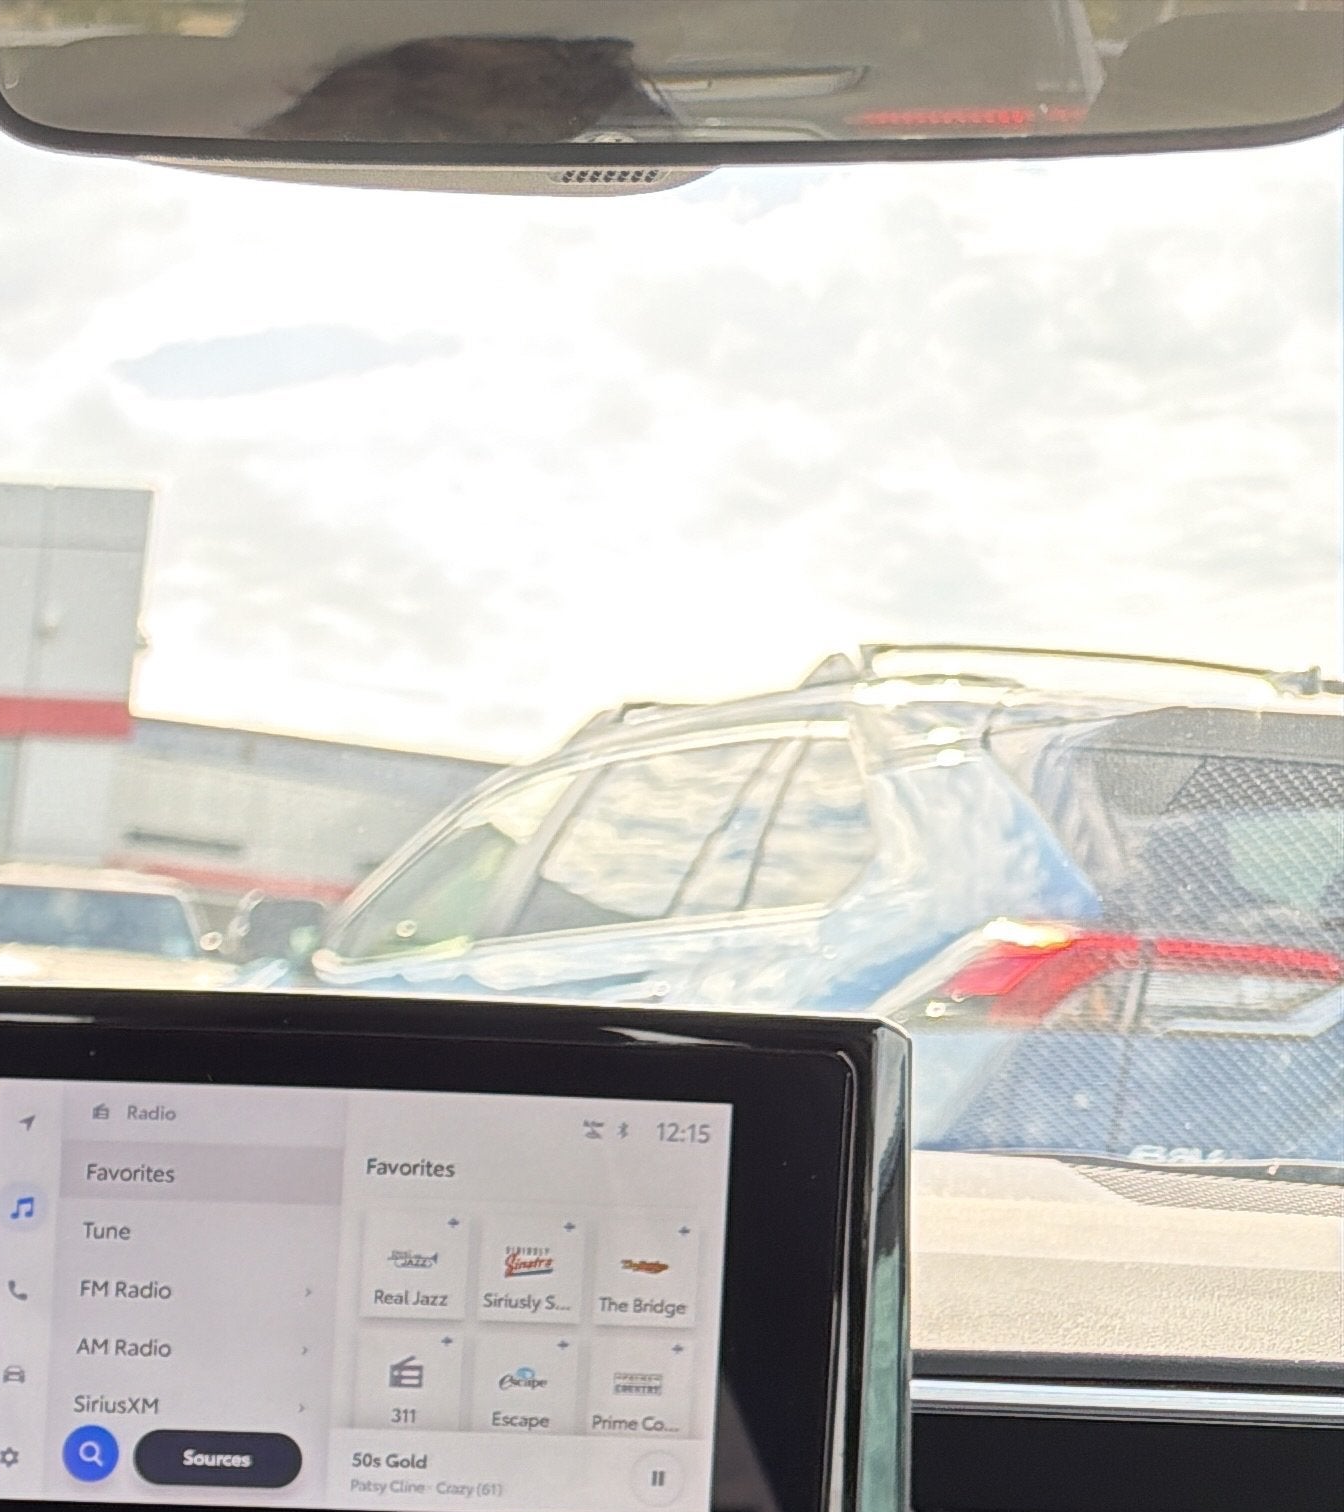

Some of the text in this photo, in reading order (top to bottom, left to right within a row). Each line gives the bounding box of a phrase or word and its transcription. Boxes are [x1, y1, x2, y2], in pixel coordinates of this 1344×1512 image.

[127, 1105, 177, 1121] Radio
[656, 1122, 711, 1144] 12:15
[86, 1164, 176, 1183] Favorites
[366, 1158, 456, 1178] Favorites
[83, 1222, 132, 1241] Tune
[79, 1280, 172, 1300] FM Radio
[374, 1290, 448, 1308] Real Jazz
[483, 1292, 542, 1313] Siriusly
[598, 1296, 687, 1317] The Bridge
[76, 1338, 172, 1358] AM Radio
[73, 1395, 160, 1415] SiriusXM
[391, 1408, 417, 1424] 311
[492, 1411, 550, 1431] Escape
[592, 1414, 638, 1431] Prime
[182, 1449, 252, 1469] Sources
[352, 1453, 428, 1470] 50s Gold
[350, 1479, 387, 1495] Patsy
[389, 1480, 425, 1494] Cline
[436, 1482, 474, 1498] Crazy
